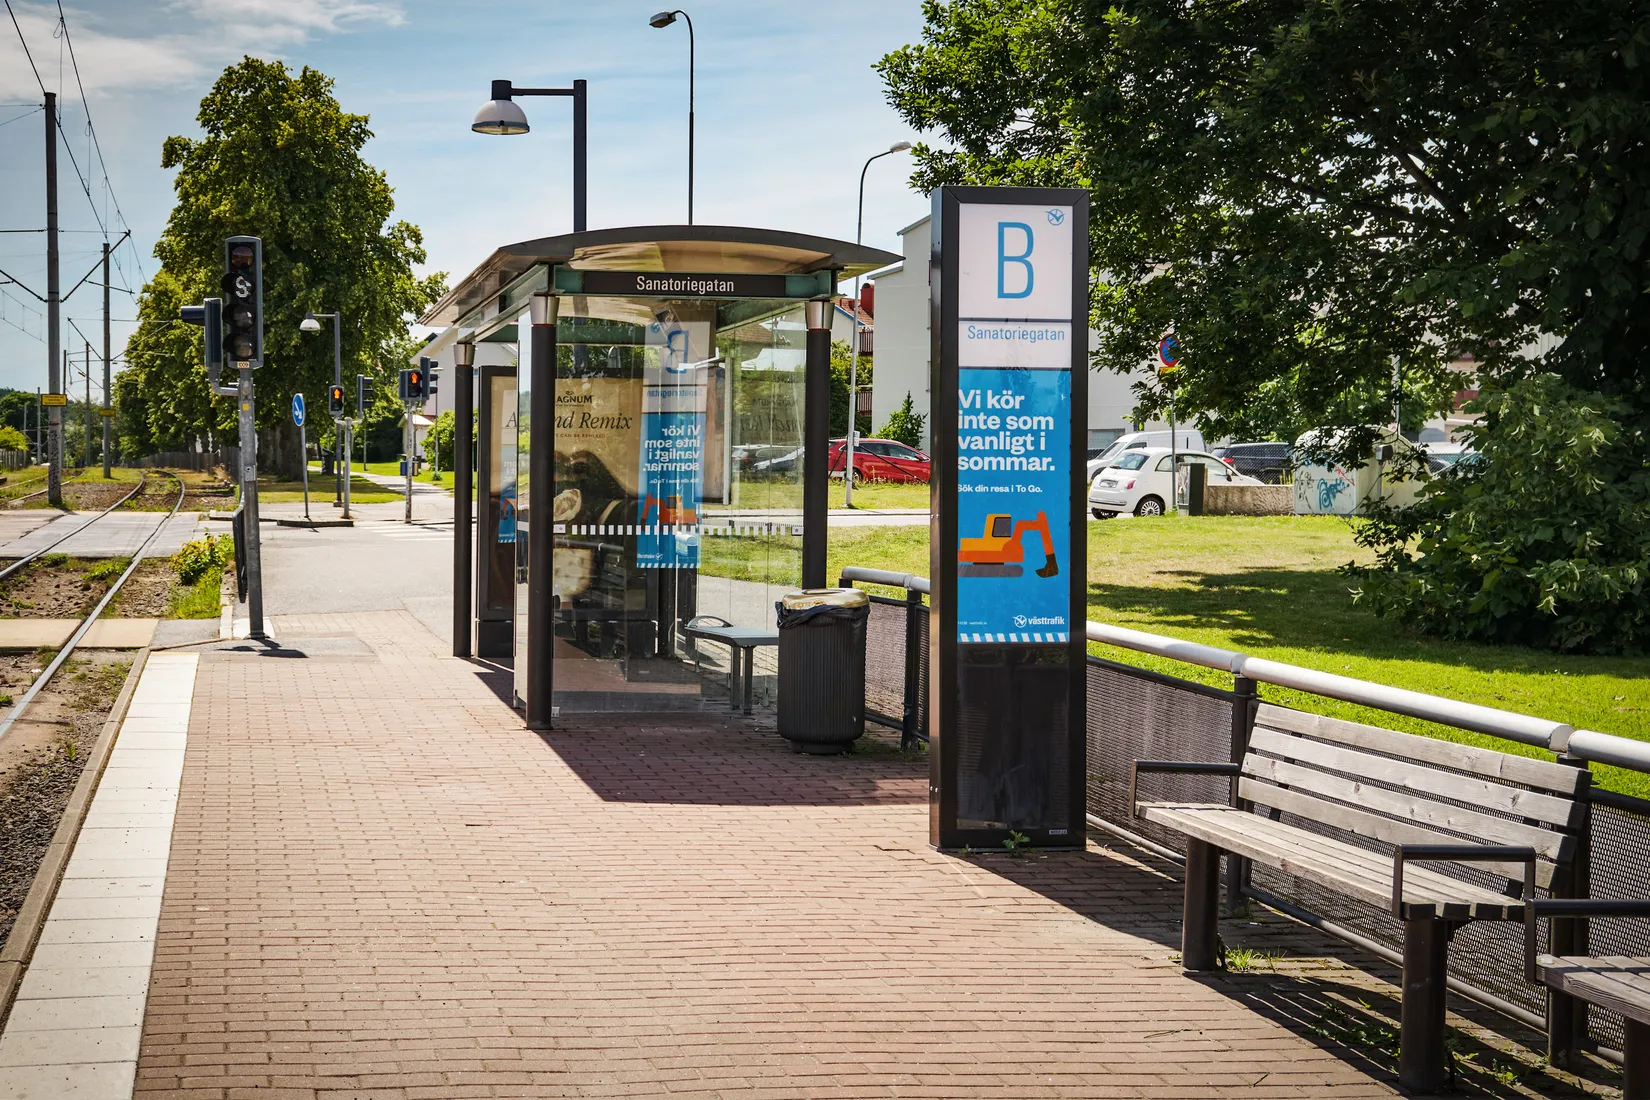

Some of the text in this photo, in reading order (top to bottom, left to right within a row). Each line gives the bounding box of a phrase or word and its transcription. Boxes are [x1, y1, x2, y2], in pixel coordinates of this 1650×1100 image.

[997, 221, 1035, 299] B
[636, 275, 734, 295] Sanatoriegatan
[967, 325, 1065, 343] Sanatoriegatan
[555, 394, 594, 404] AGNUM
[958, 389, 1025, 410] Vi kör
[578, 411, 633, 430] Remix
[958, 410, 1054, 430] inte som
[958, 431, 1046, 455] vanligt i
[958, 455, 1055, 471] sommar.
[975, 484, 989, 493] din
[1011, 484, 1014, 493] i
[1015, 484, 1026, 493] To
[1028, 484, 1043, 493] Go.
[1028, 616, 1065, 625] västtrafik
